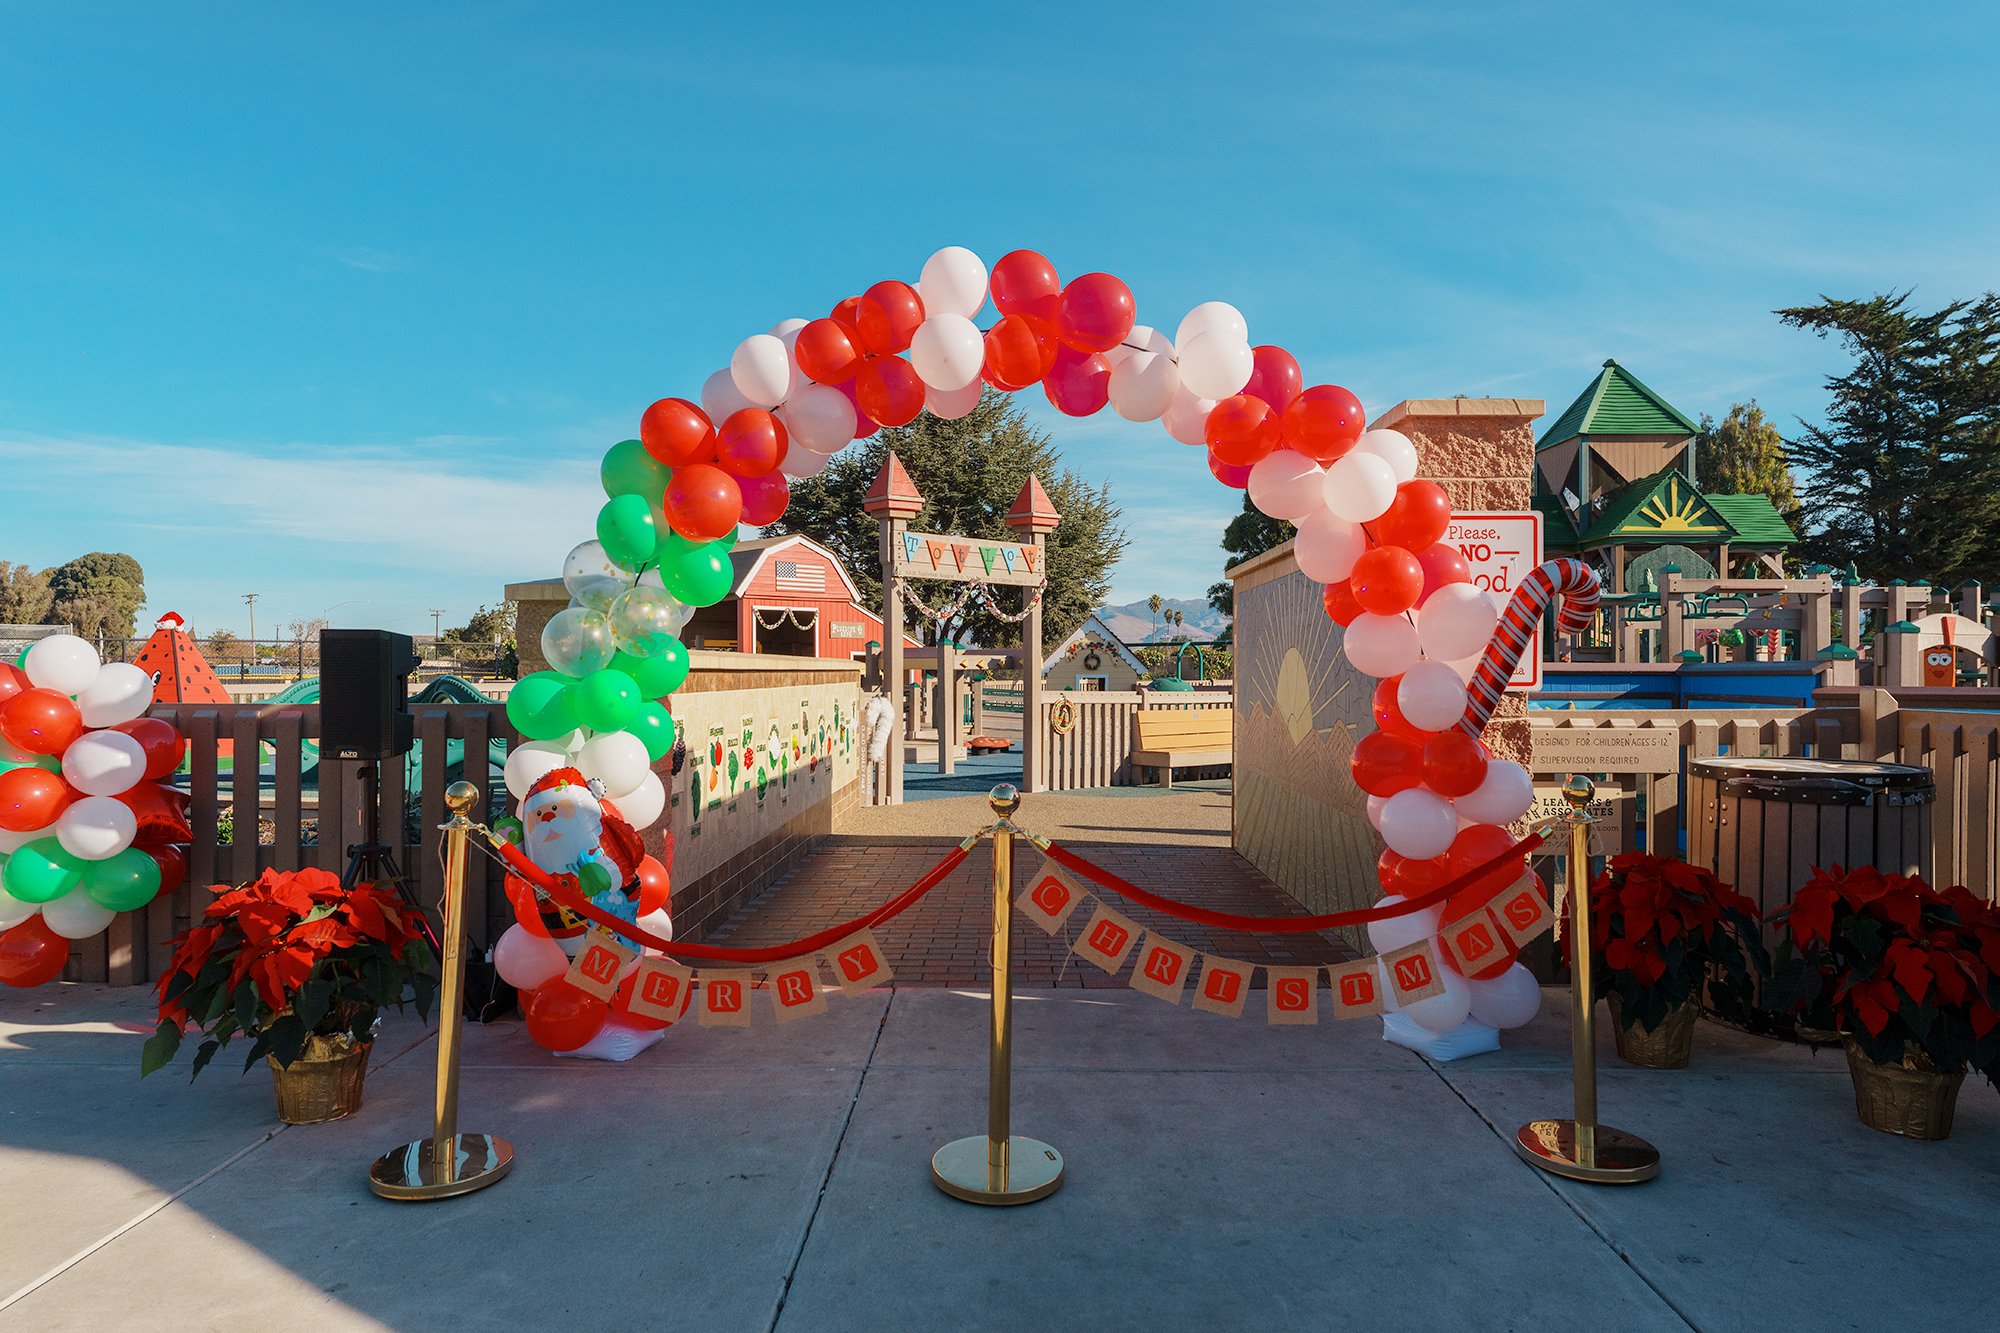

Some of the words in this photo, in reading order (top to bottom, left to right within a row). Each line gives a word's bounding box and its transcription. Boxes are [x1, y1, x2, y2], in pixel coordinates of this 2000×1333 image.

[1448, 525, 1501, 540] Please,
[907, 536, 965, 563] Tot
[985, 548, 1035, 564] Lot
[1459, 544, 1491, 562] NO
[1534, 738, 1570, 747] DESIGNED
[1575, 738, 1591, 747] FOR
[1593, 737, 1631, 747] CHILDREN
[1631, 738, 1650, 747] AGES
[1539, 756, 1596, 765] SUPERVISION
[1599, 756, 1640, 765] REQUIRED
[1543, 798, 1602, 807] LEATRS
[1543, 807, 1614, 816] ASSOATES
[584, 944, 876, 1010] MERRY
[1037, 884, 1541, 1009] CHRISTMAS
